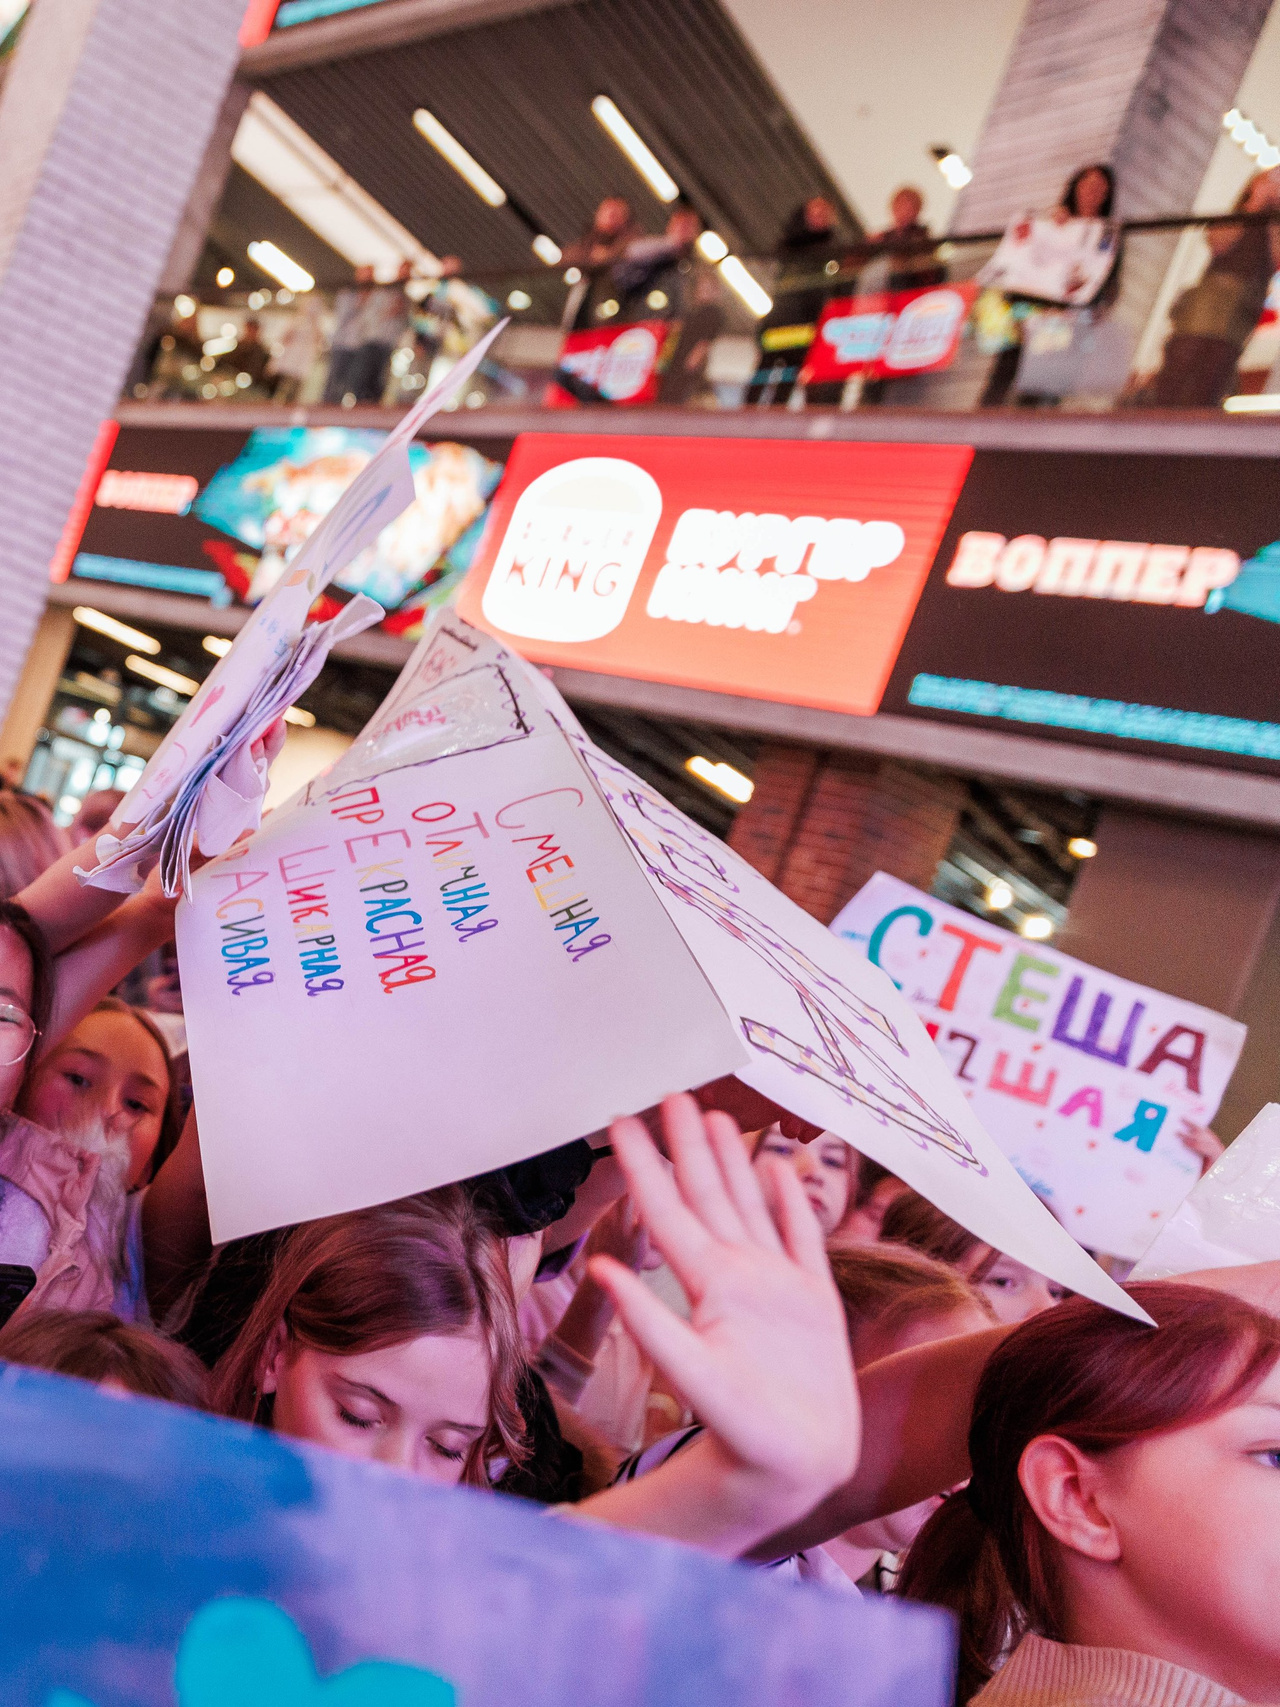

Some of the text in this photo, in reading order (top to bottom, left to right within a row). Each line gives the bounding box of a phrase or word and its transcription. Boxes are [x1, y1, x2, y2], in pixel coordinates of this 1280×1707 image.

[505, 554, 622, 598] KING
[946, 531, 1240, 608] ВОППЕР
[278, 845, 344, 996] ШИКАРНАЯ
[328, 787, 436, 994] ПРЕКРАСНАЯ
[411, 802, 498, 942] ОТЛИЧНАЯ
[495, 787, 612, 962] СМЕШНАЯ
[868, 905, 1206, 1095] СТЕША
